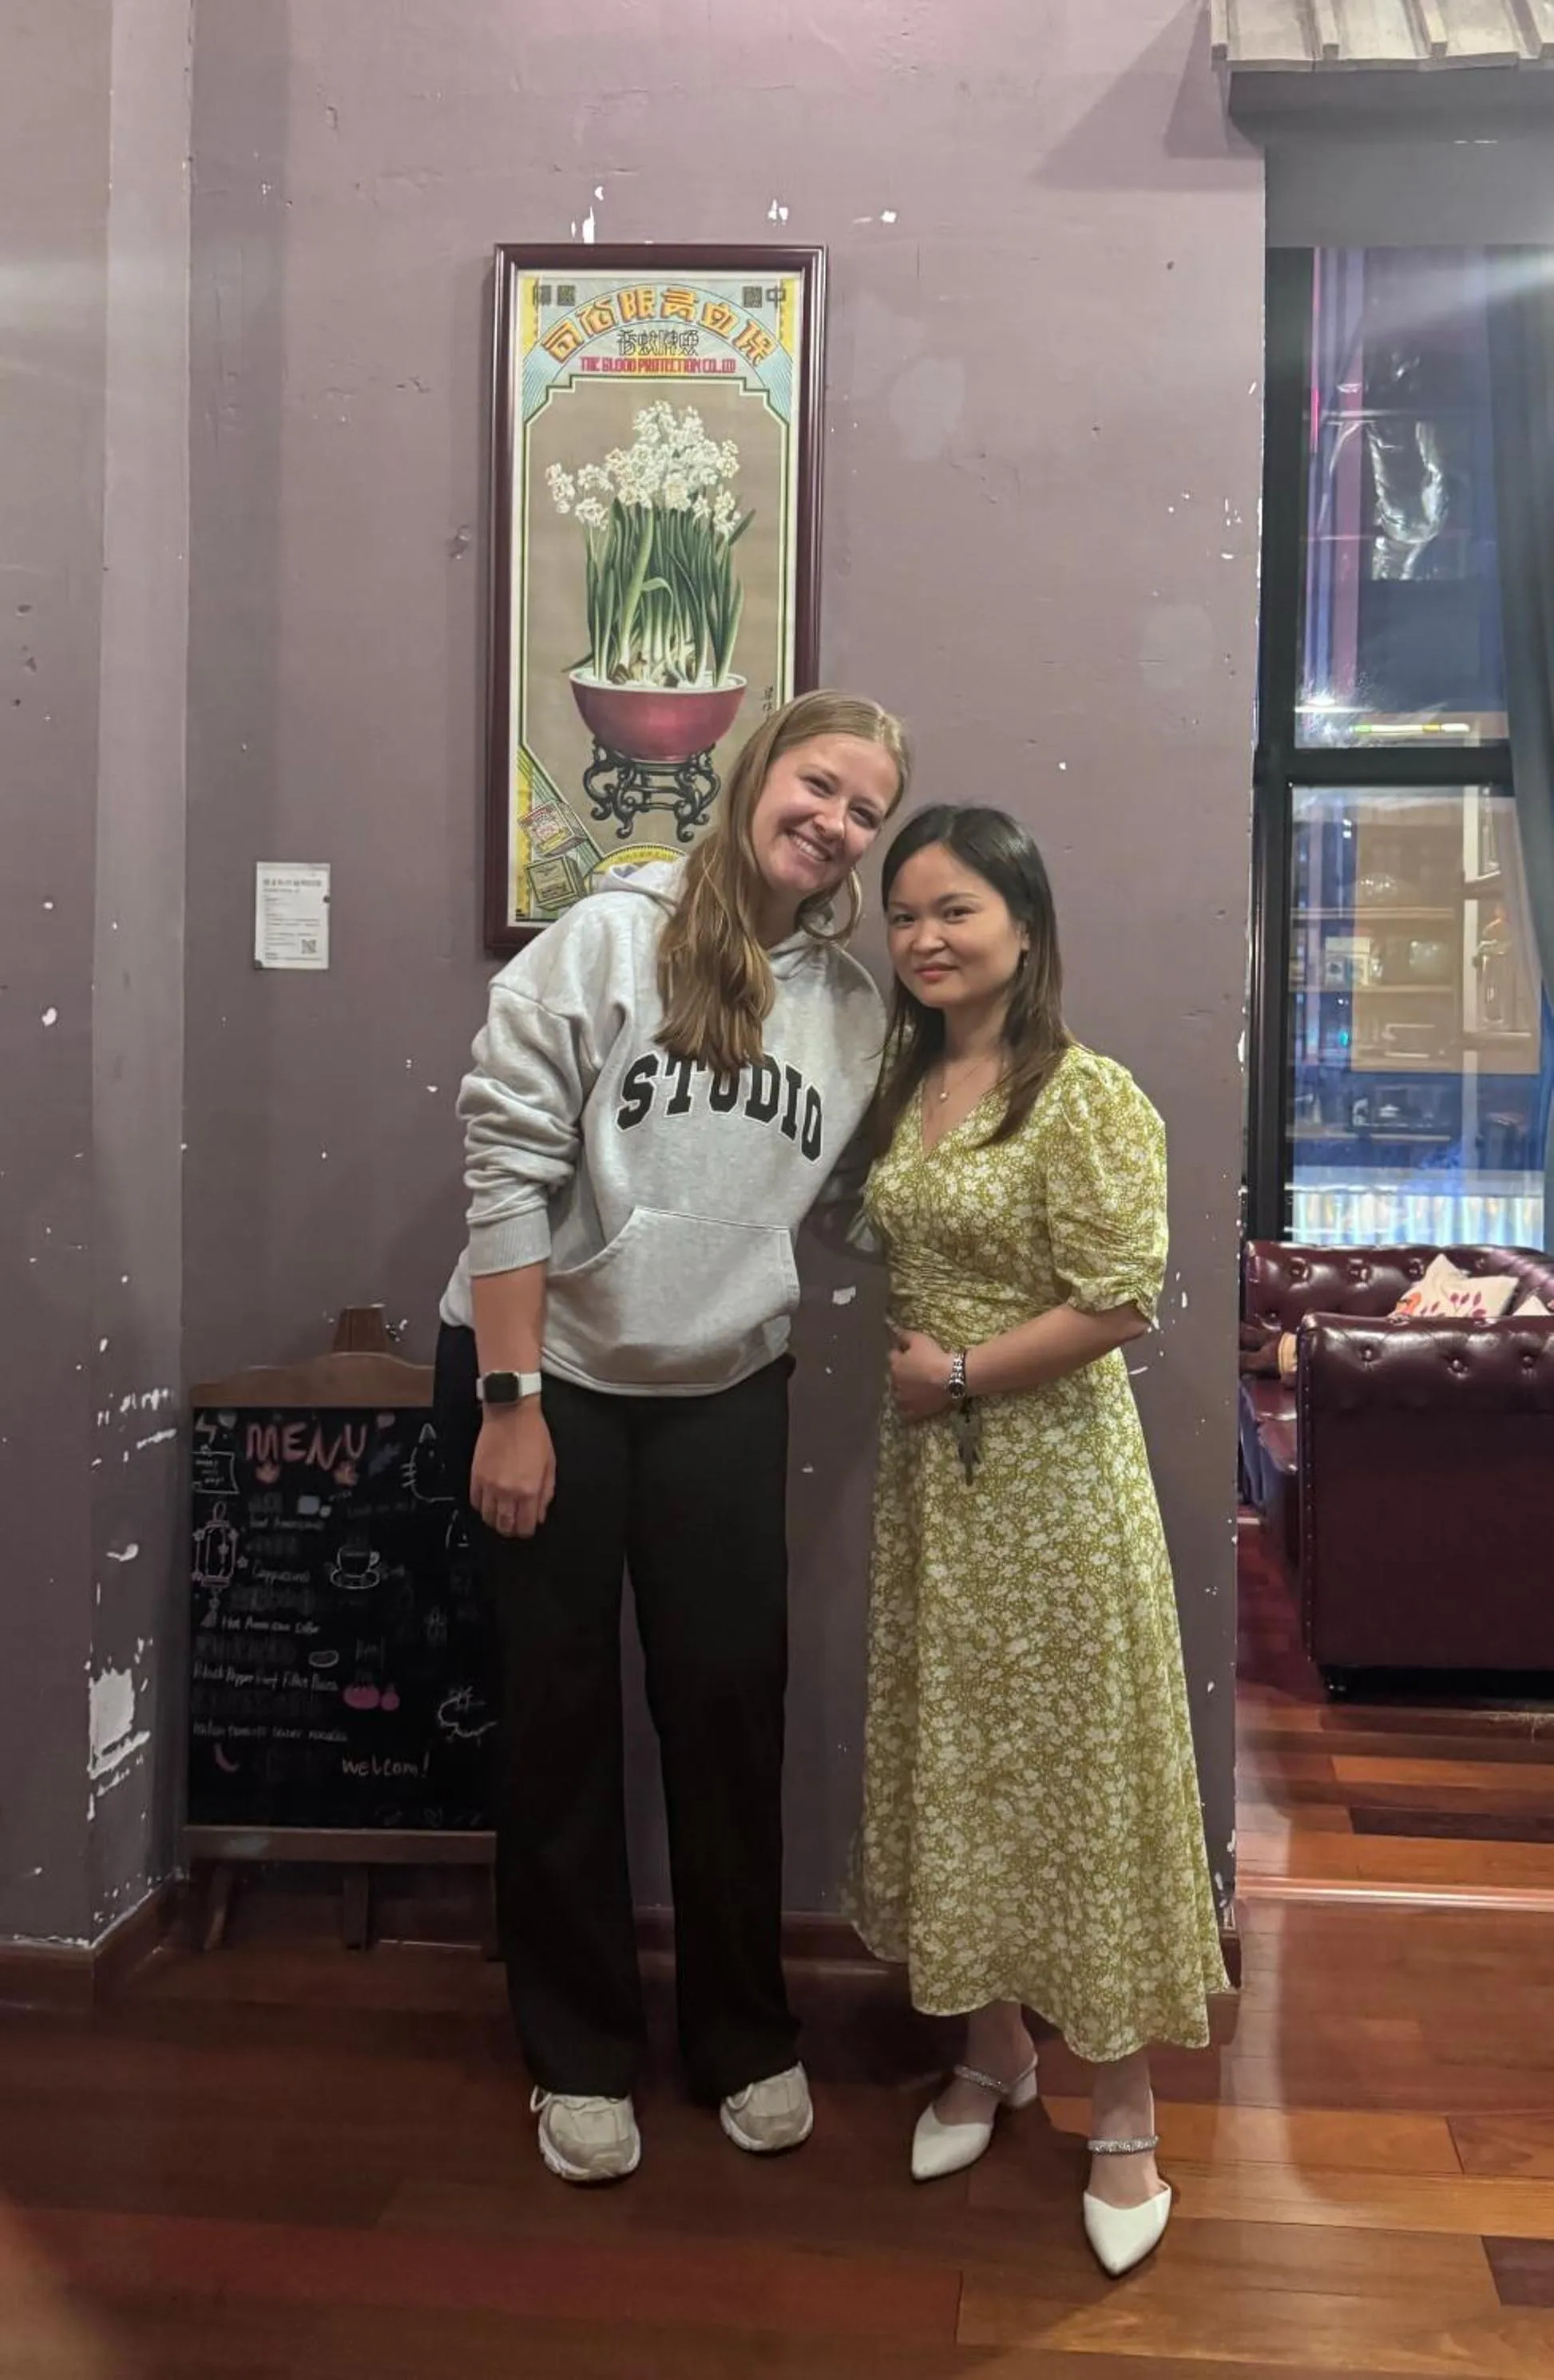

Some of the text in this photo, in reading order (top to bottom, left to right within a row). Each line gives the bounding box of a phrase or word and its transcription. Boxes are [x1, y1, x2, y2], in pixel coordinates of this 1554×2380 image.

[602, 357, 636, 373] BLOOD
[638, 358, 700, 374] PROTECTION
[616, 1051, 823, 1164] STUDIO
[247, 1422, 368, 1470] MENU
